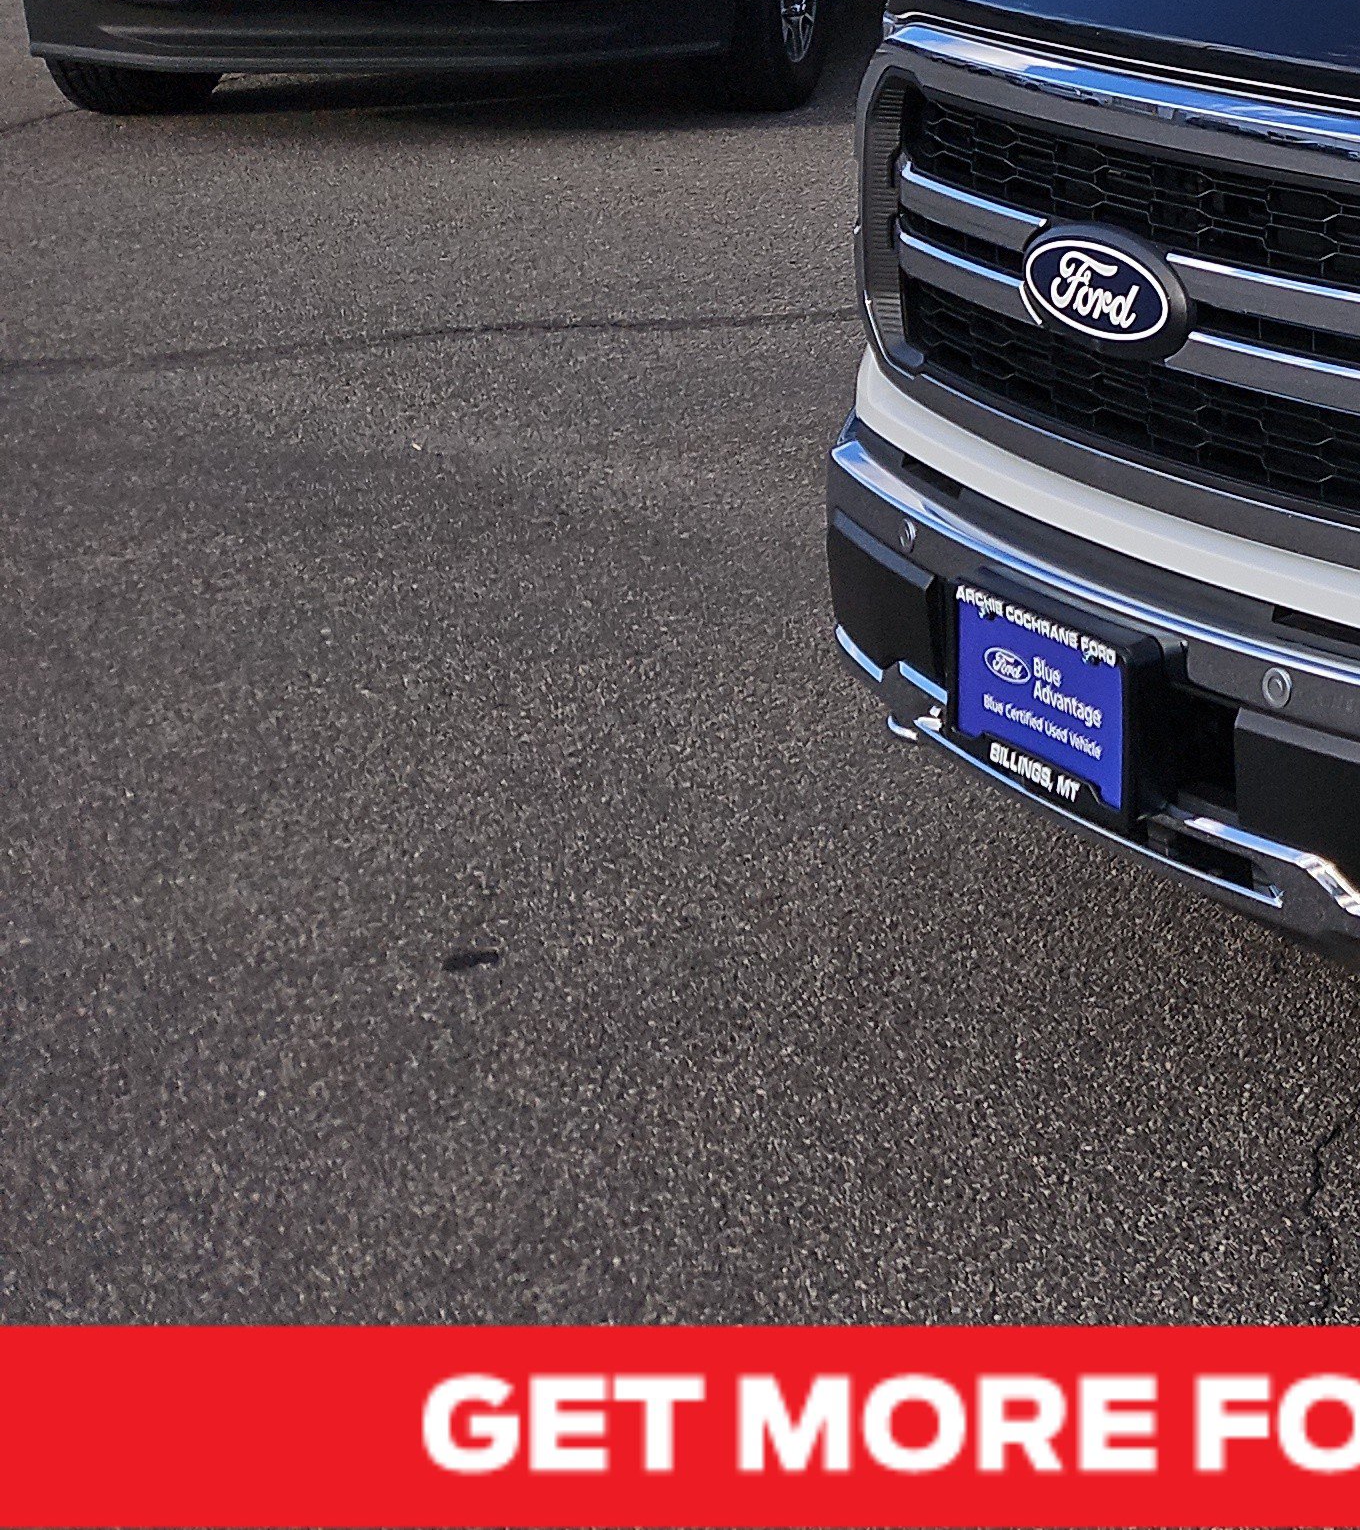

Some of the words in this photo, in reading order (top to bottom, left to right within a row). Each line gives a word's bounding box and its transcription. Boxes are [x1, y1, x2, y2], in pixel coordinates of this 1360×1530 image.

[1050, 250, 1140, 329] Ford
[956, 584, 1004, 615] ARCHIE
[1005, 604, 1079, 650] COCHRANE
[1081, 636, 1117, 668] FORD
[1032, 656, 1062, 688] Blue
[983, 693, 1004, 716] Blue
[1005, 701, 1044, 732] Certified
[1045, 719, 1068, 743] Used
[1068, 731, 1103, 760] Vehicle
[1033, 682, 1103, 729] Advantage
[989, 741, 1053, 792] BILLINGS,
[1057, 774, 1080, 802] MT
